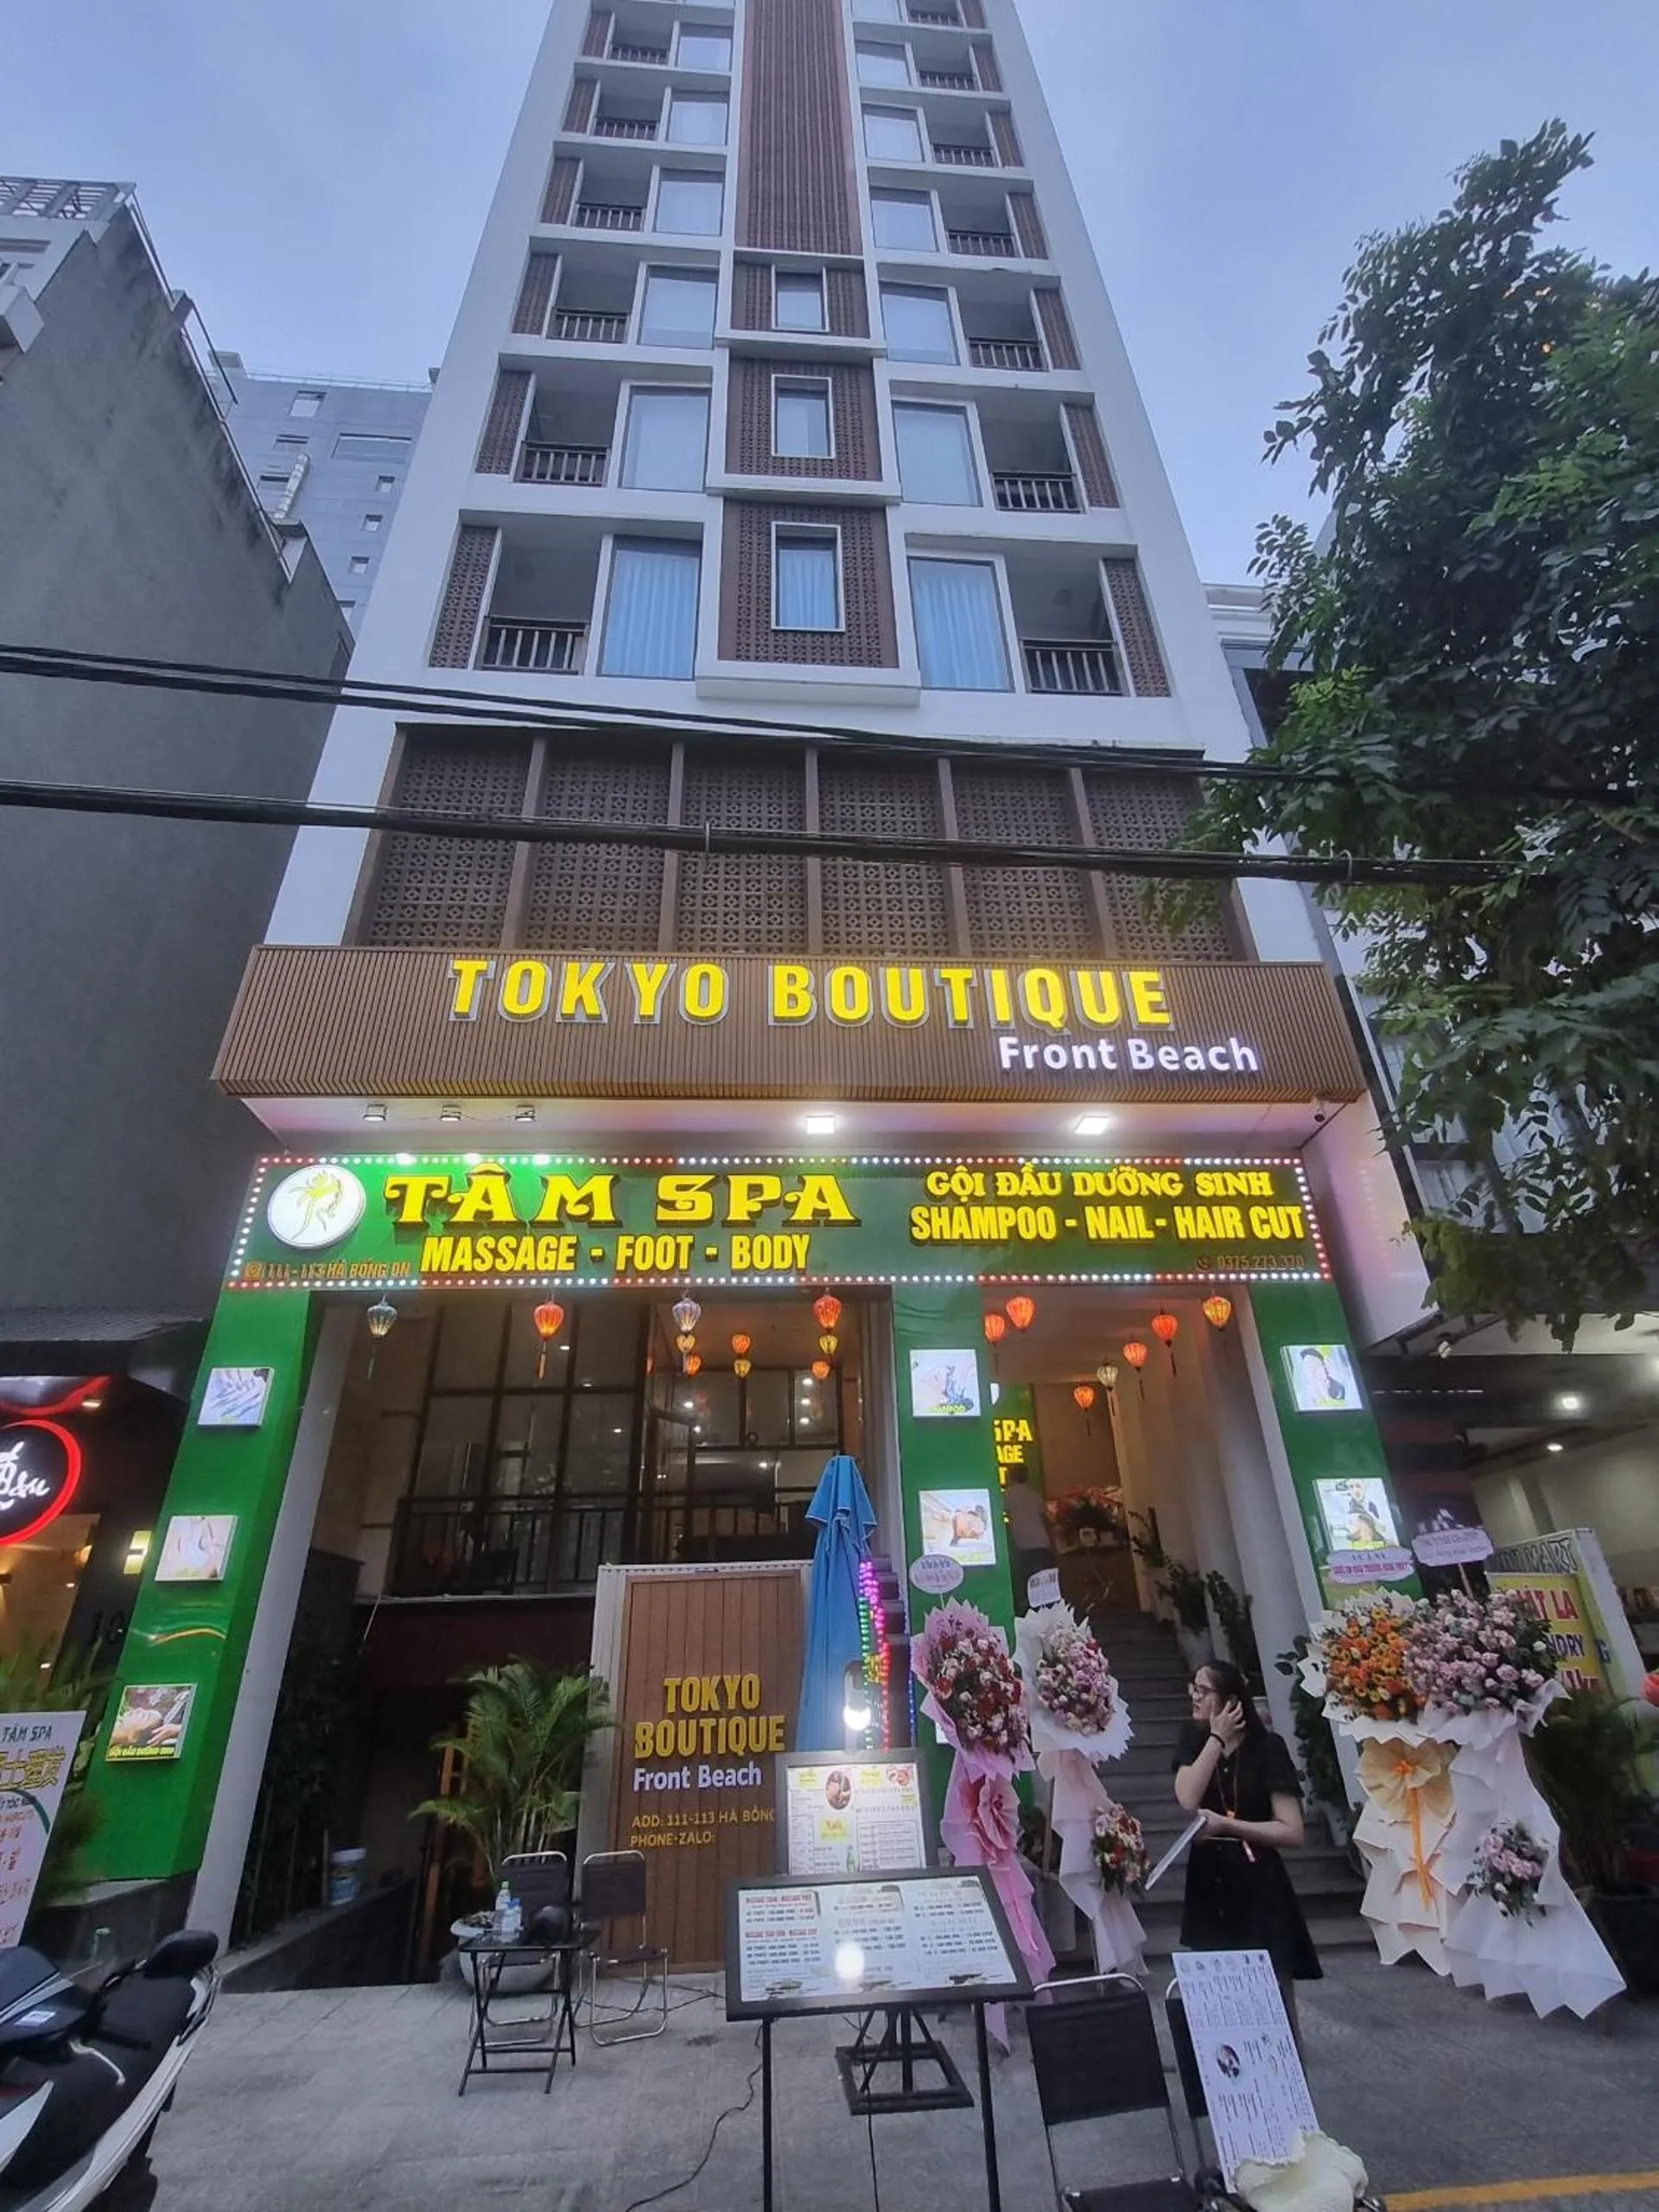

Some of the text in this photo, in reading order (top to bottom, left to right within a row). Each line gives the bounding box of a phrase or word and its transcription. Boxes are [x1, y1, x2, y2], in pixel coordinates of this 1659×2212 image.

[448, 959, 1175, 1034] TOKYO BOUTIQUE
[999, 1037, 1259, 1072] Front Beach
[385, 1162, 860, 1224] TÂM SPA
[927, 1165, 986, 1202] GỘI
[1196, 1172, 1274, 1196] SINH
[911, 1206, 1057, 1240] SHAMPOO
[1084, 1206, 1155, 1239] NAIL
[1173, 1206, 1245, 1239] HAIR
[1249, 1206, 1305, 1240] CUT
[421, 1236, 576, 1273] MASSAGE
[615, 1235, 694, 1271] FOOT
[731, 1234, 810, 1270] BODY
[664, 1674, 760, 1713] TOKYO
[634, 1715, 785, 1758] BOUTIQUE
[633, 1761, 761, 1791] Front Beach
